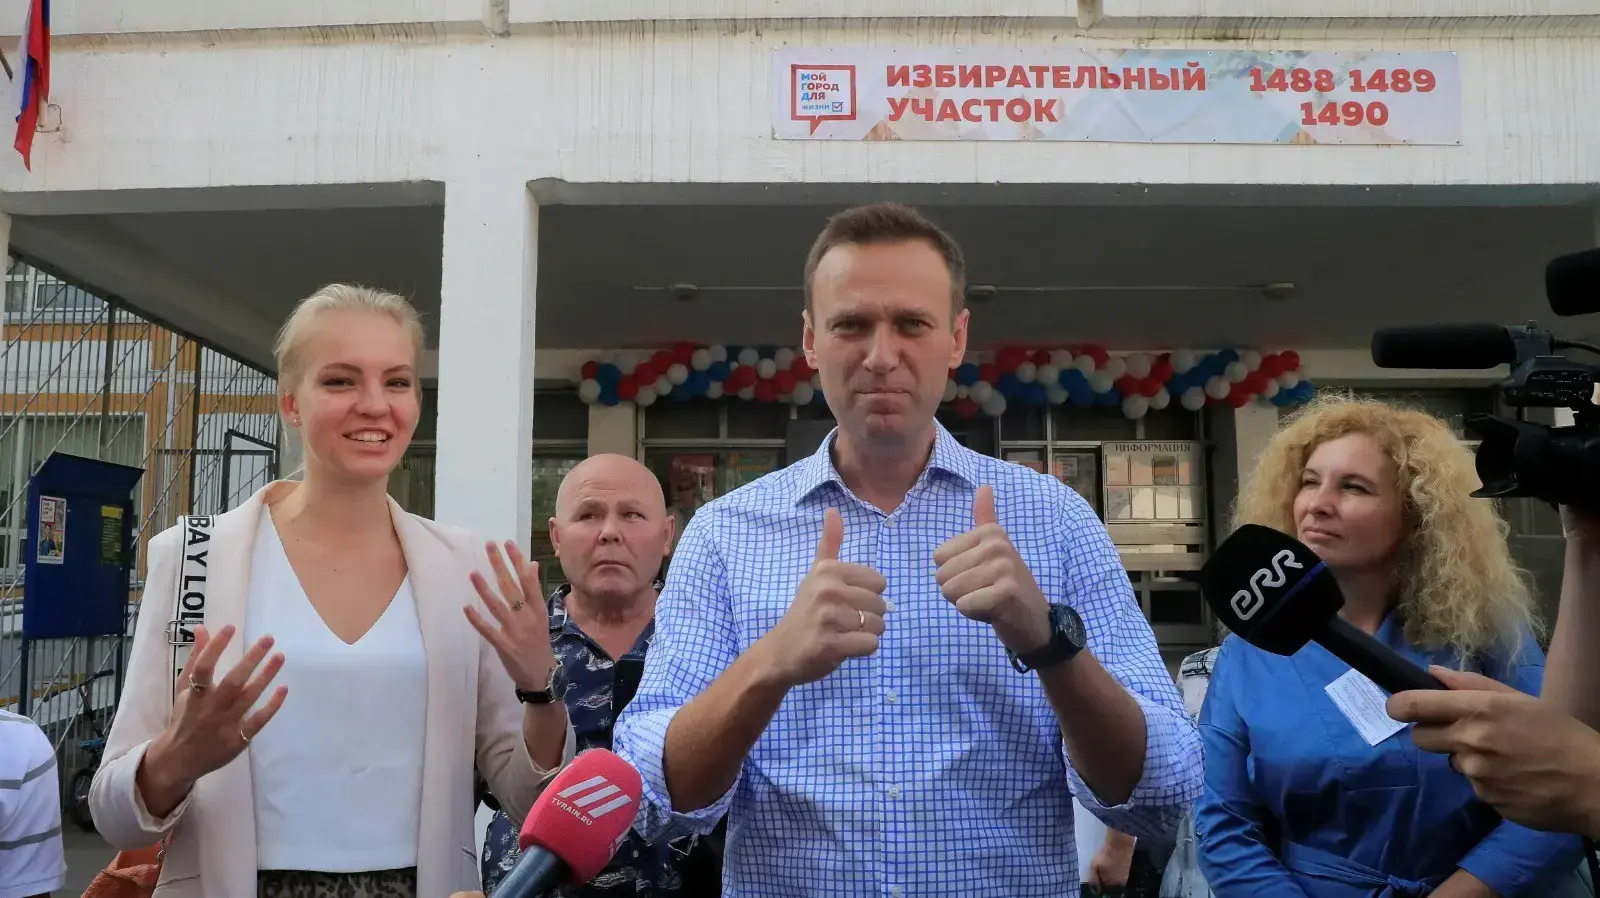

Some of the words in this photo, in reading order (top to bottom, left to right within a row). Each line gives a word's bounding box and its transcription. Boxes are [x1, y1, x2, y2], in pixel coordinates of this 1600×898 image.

[801, 82, 839, 92] ГОРОД
[886, 61, 1206, 91] ИЗБИРАТЕЛЬНЫЙ
[1249, 68, 1336, 93] 1488
[1349, 68, 1436, 93] 1489
[801, 92, 826, 101] ДЛЯ
[886, 97, 1058, 123] УЧАСТОК
[1300, 101, 1389, 126] 1490
[1115, 443, 1191, 452] ИНФОРМАЦИЯ
[187, 515, 210, 546] BA
[551, 797, 593, 826] TVRAIN.RU
